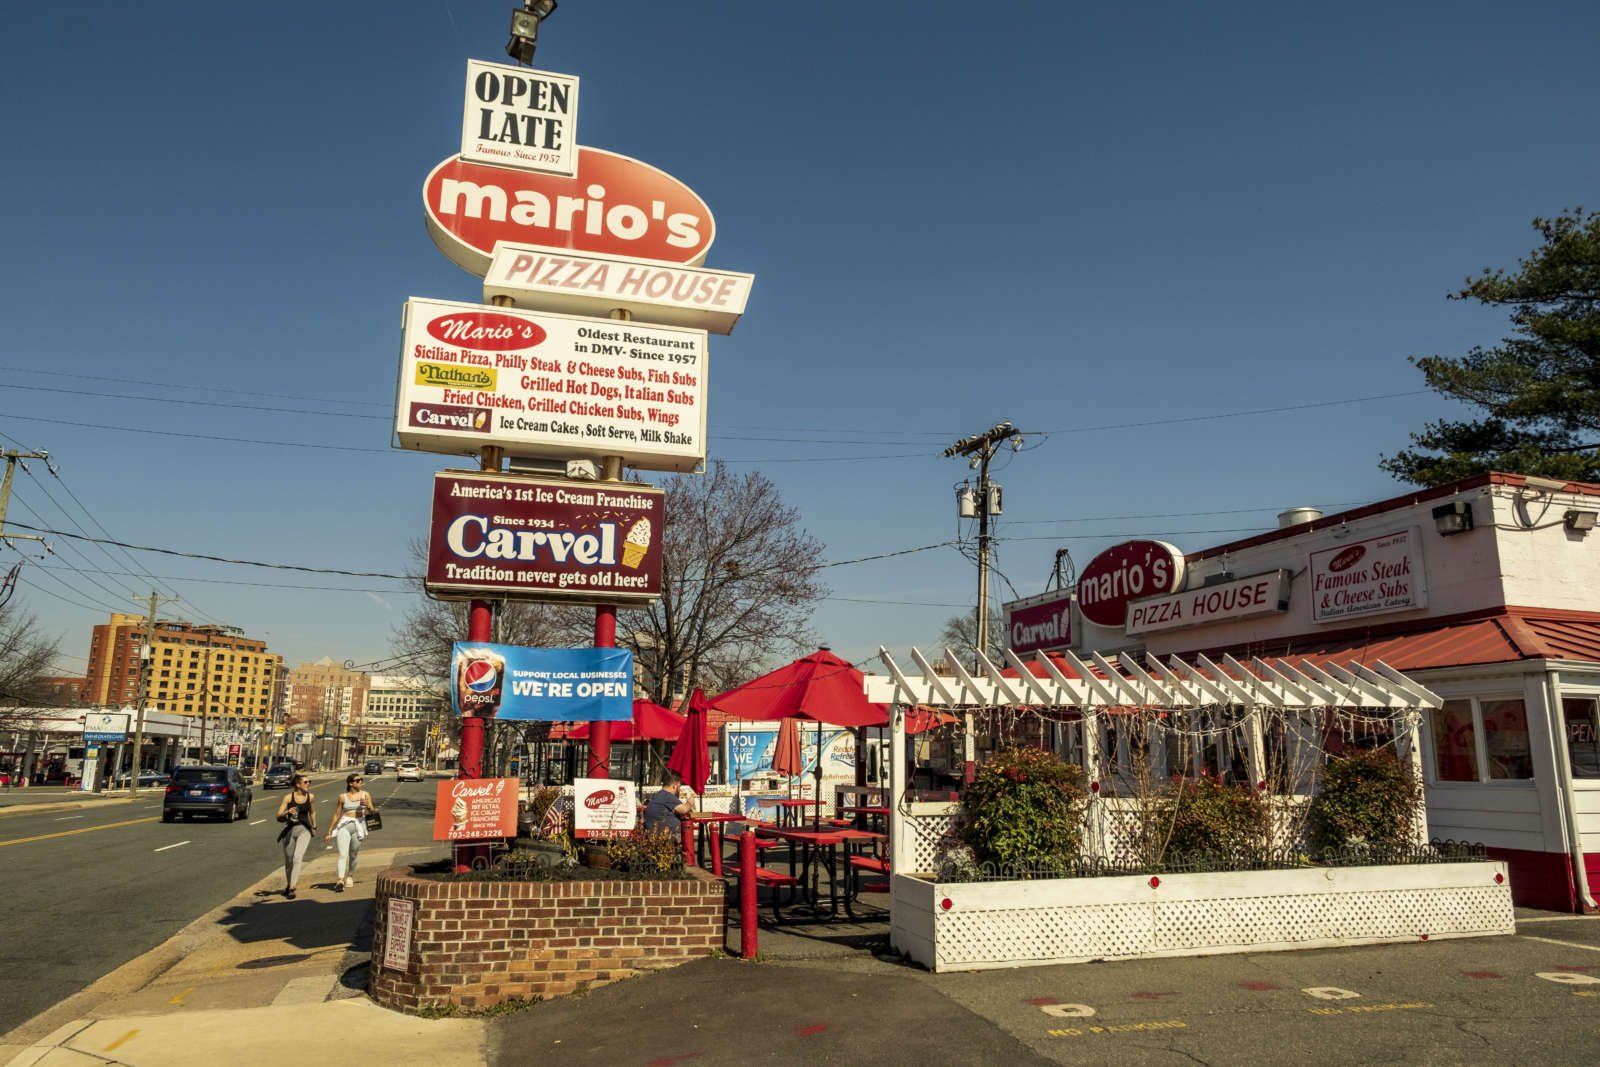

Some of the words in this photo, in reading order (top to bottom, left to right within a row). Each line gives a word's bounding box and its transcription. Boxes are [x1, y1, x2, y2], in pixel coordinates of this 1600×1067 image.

[475, 71, 570, 114] OPEN
[478, 108, 563, 151] LATE
[475, 143, 511, 158] Famous
[513, 149, 537, 162] Since
[538, 153, 561, 164] 1957
[439, 178, 701, 249] mario's
[504, 253, 611, 291] PIZZA
[616, 264, 737, 306] HOUSE
[440, 319, 533, 341] Mario's
[577, 327, 620, 342] Oldest
[622, 331, 695, 350] Restaurant
[414, 344, 458, 363] Sicilian
[460, 349, 492, 368] Pizza,
[495, 353, 527, 371] Philly
[530, 356, 561, 373] Steak
[567, 360, 577, 374] &
[579, 361, 615, 379] Cheese
[617, 364, 646, 382] Subs,
[648, 368, 669, 384] Fish
[672, 371, 697, 387] Subs
[574, 342, 588, 353] in
[630, 348, 664, 361] Since
[668, 353, 697, 365] 1957
[419, 364, 491, 384] Nathan's
[520, 375, 563, 393] Grilled
[566, 379, 588, 396] Hot
[590, 382, 622, 400] Dogs,
[624, 383, 665, 403] Italian
[668, 388, 695, 406] Subs
[416, 409, 474, 427] Carvel
[443, 389, 474, 405] Fried
[476, 391, 525, 413] Chicken,
[528, 396, 567, 414] Grilled
[569, 399, 614, 418] Chicken
[616, 404, 645, 422] Subs,
[648, 408, 680, 426] Wings
[500, 416, 514, 430] Ice
[516, 418, 548, 433] Cream
[586, 424, 605, 437] Soft
[608, 426, 637, 443] Serve,
[640, 429, 662, 443] Milk
[663, 431, 692, 446] Shake
[451, 482, 512, 501] America's
[515, 488, 533, 501] 1st
[536, 489, 553, 503] Ice
[556, 490, 594, 506] Cream
[597, 492, 653, 509] Franchise
[493, 515, 525, 526] Since
[527, 518, 554, 528] 1934
[447, 515, 616, 565] Carvel
[446, 563, 514, 582] Tradition
[517, 570, 556, 584] never
[559, 572, 587, 588] gets
[590, 571, 612, 586] old
[614, 572, 648, 588] here!
[1081, 552, 1167, 606] mario's
[1315, 569, 1368, 591] Famous
[1371, 555, 1411, 581] Steak
[1132, 600, 1182, 629] PIZZA
[1194, 582, 1269, 617] HOUSE
[1321, 592, 1330, 609] &
[1334, 588, 1376, 606] Cheese
[1378, 580, 1408, 600] Subs
[1013, 613, 1059, 646] Carvel
[513, 670, 551, 679] SUPPORT
[553, 671, 579, 679] LOCAL
[581, 671, 627, 679] BUSINESSES
[464, 694, 494, 705] pepsi
[512, 681, 573, 697] WE'RE
[577, 682, 627, 697] OPEN
[730, 735, 757, 746] YOU
[733, 752, 753, 764] WE
[1089, 1020, 1187, 1035] PARKING
